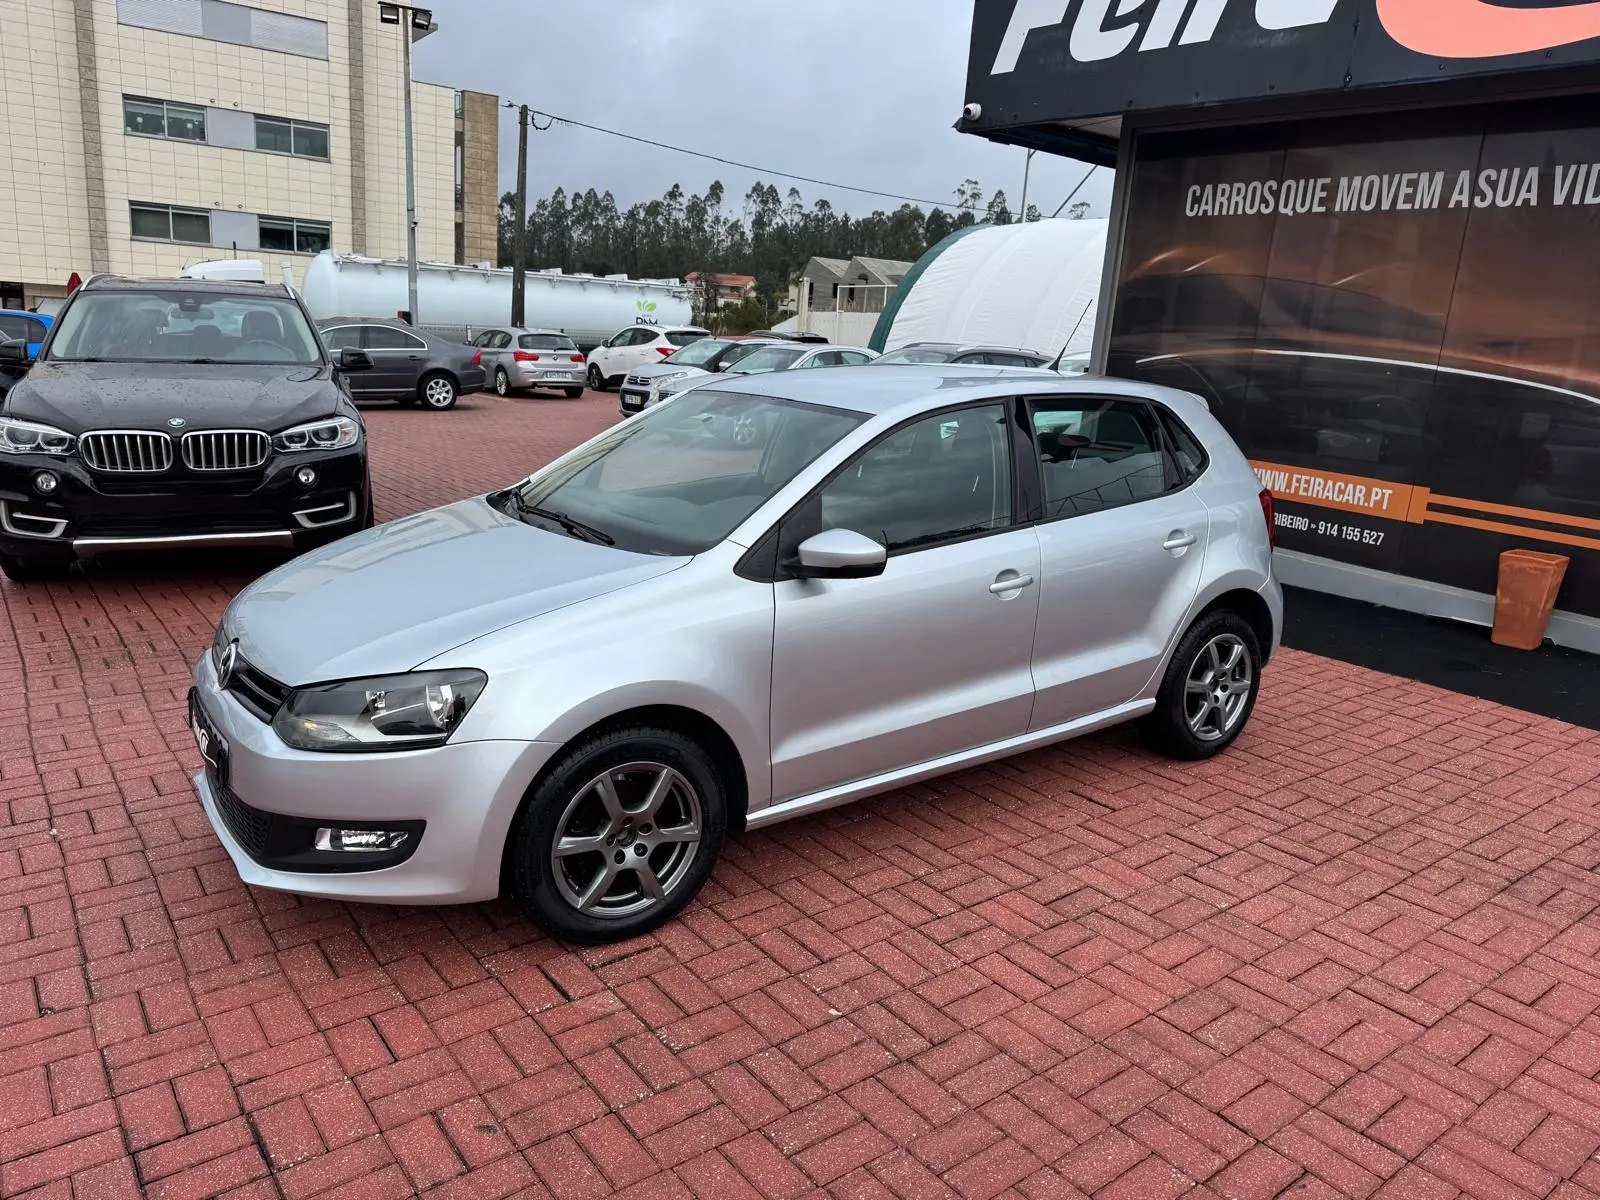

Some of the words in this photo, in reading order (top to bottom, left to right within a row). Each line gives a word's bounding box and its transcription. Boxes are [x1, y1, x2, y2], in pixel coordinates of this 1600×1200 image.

[1334, 171, 1445, 212] MOVEM
[1317, 520, 1338, 537] 914
[1341, 526, 1361, 542] 155
[1362, 530, 1385, 546] 527
